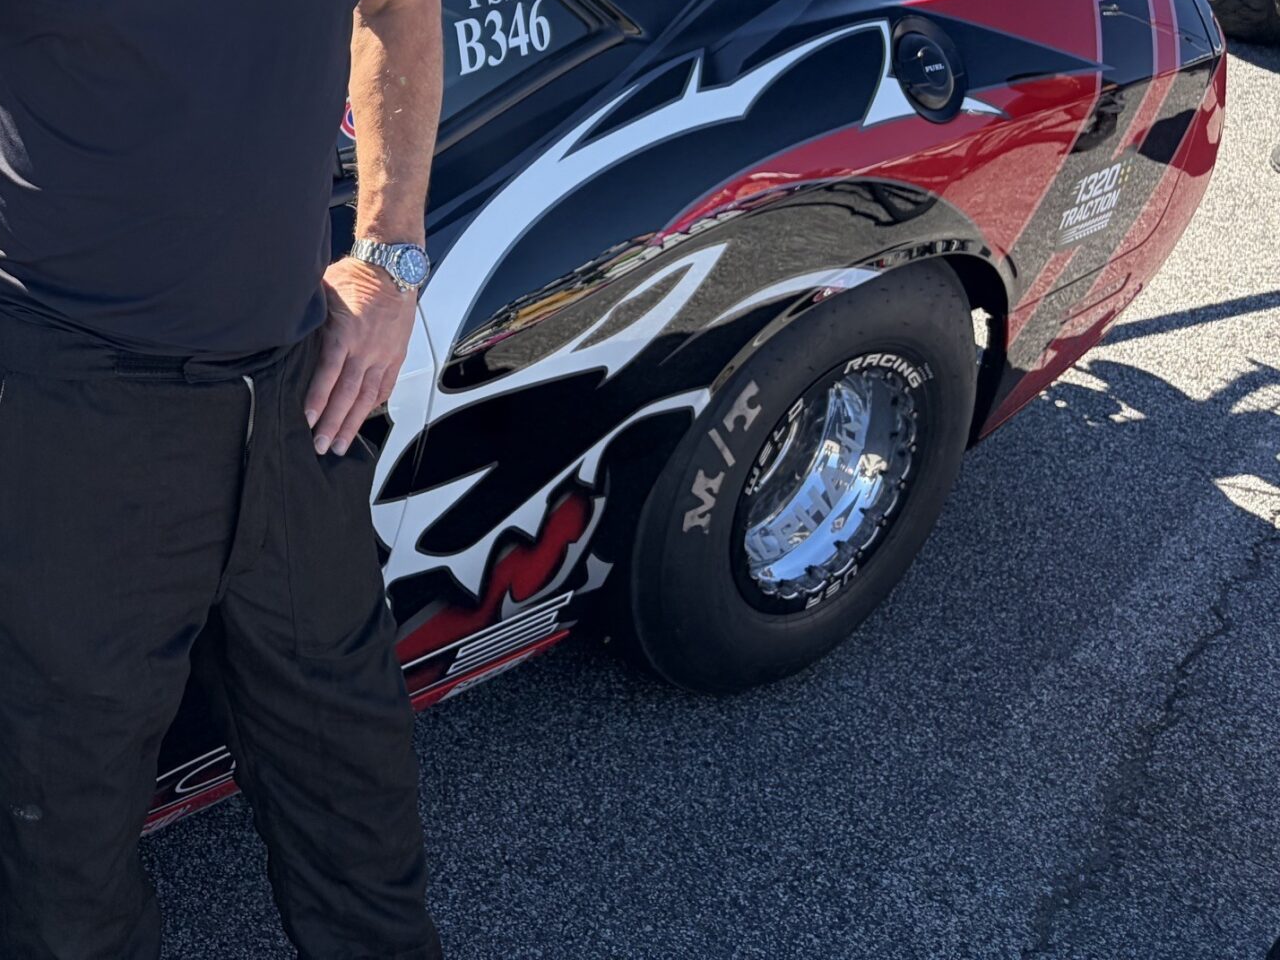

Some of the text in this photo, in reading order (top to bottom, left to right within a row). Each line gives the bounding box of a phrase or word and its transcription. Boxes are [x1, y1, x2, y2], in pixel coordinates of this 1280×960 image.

[1075, 163, 1122, 205] 1320
[1059, 188, 1121, 230] TRACTION
[843, 353, 922, 389] RACING
[682, 379, 762, 535] M/T
[744, 397, 804, 496] WELD
[805, 564, 858, 611] USA
